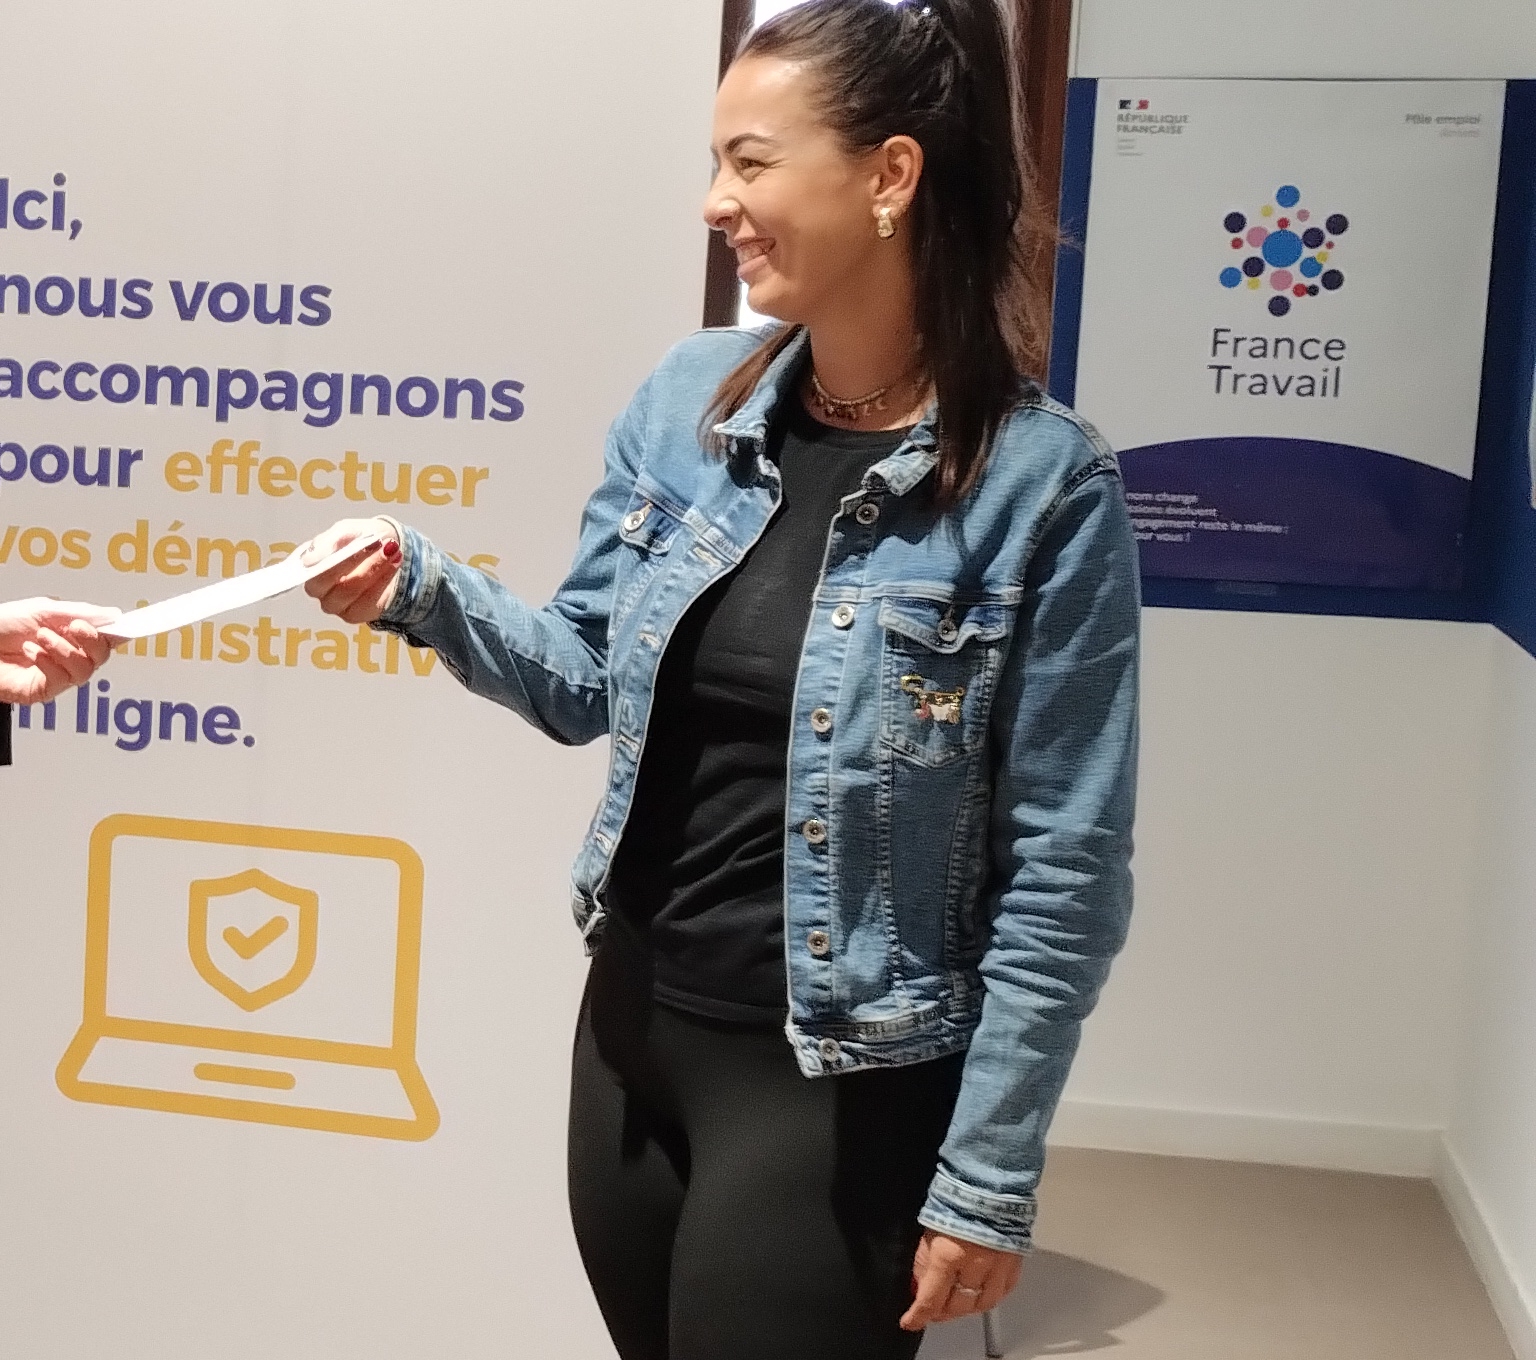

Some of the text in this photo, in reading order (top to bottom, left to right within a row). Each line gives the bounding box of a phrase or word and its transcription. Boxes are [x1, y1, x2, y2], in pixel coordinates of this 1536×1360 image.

[168, 280, 332, 326] vous
[1211, 327, 1346, 363] France
[1207, 365, 1341, 399] Travail
[164, 439, 490, 508] effectuer
[18, 678, 256, 751] n ligne.
